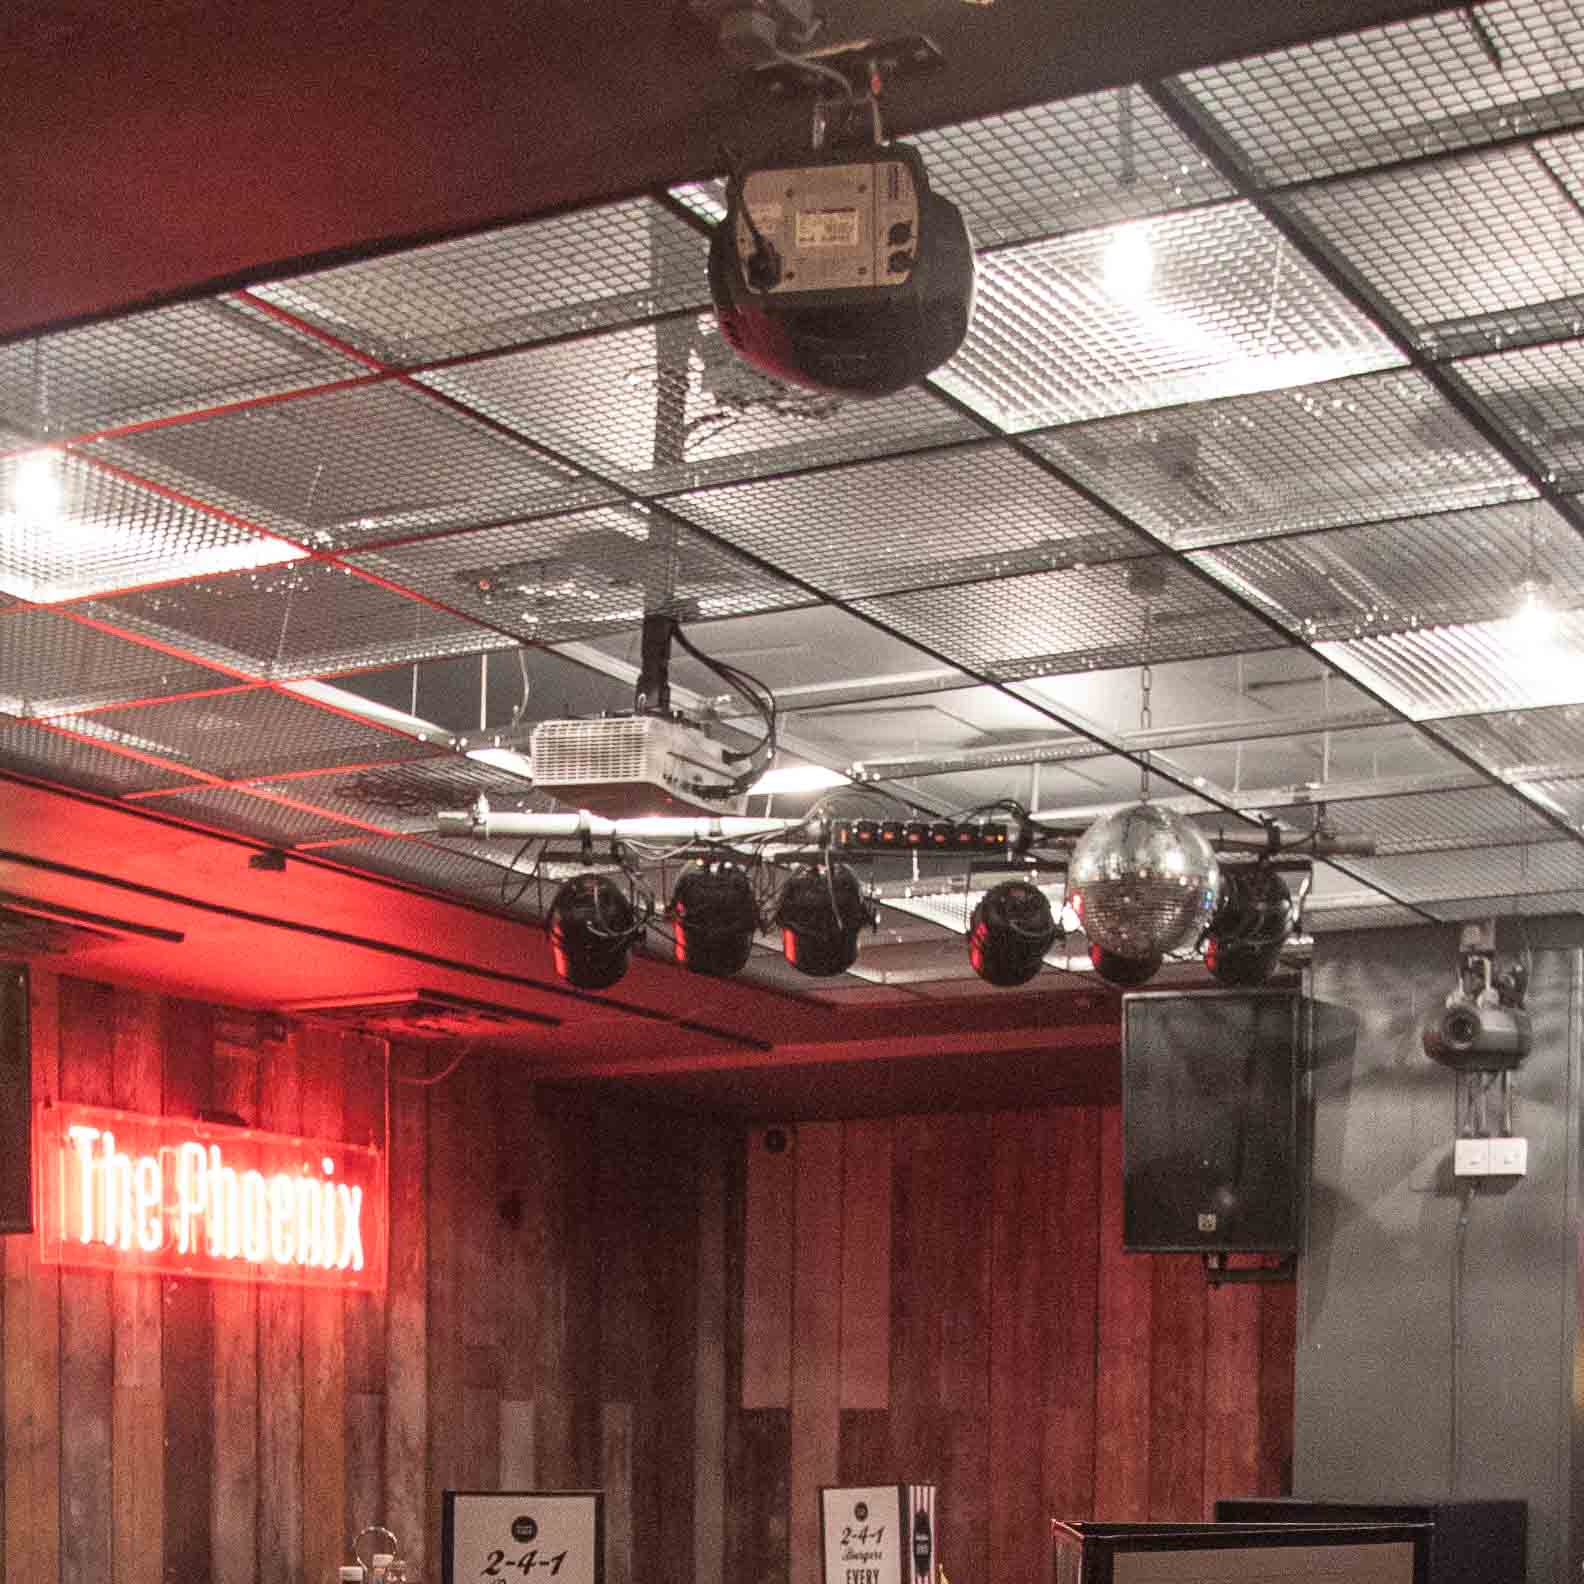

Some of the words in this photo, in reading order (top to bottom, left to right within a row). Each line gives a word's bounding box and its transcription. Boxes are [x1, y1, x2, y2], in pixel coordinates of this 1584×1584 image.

[68, 1126, 161, 1251] The
[178, 1141, 363, 1272] Phoenix
[840, 1525, 885, 1545] 2-4-1
[481, 1550, 568, 1576] 2-4-1
